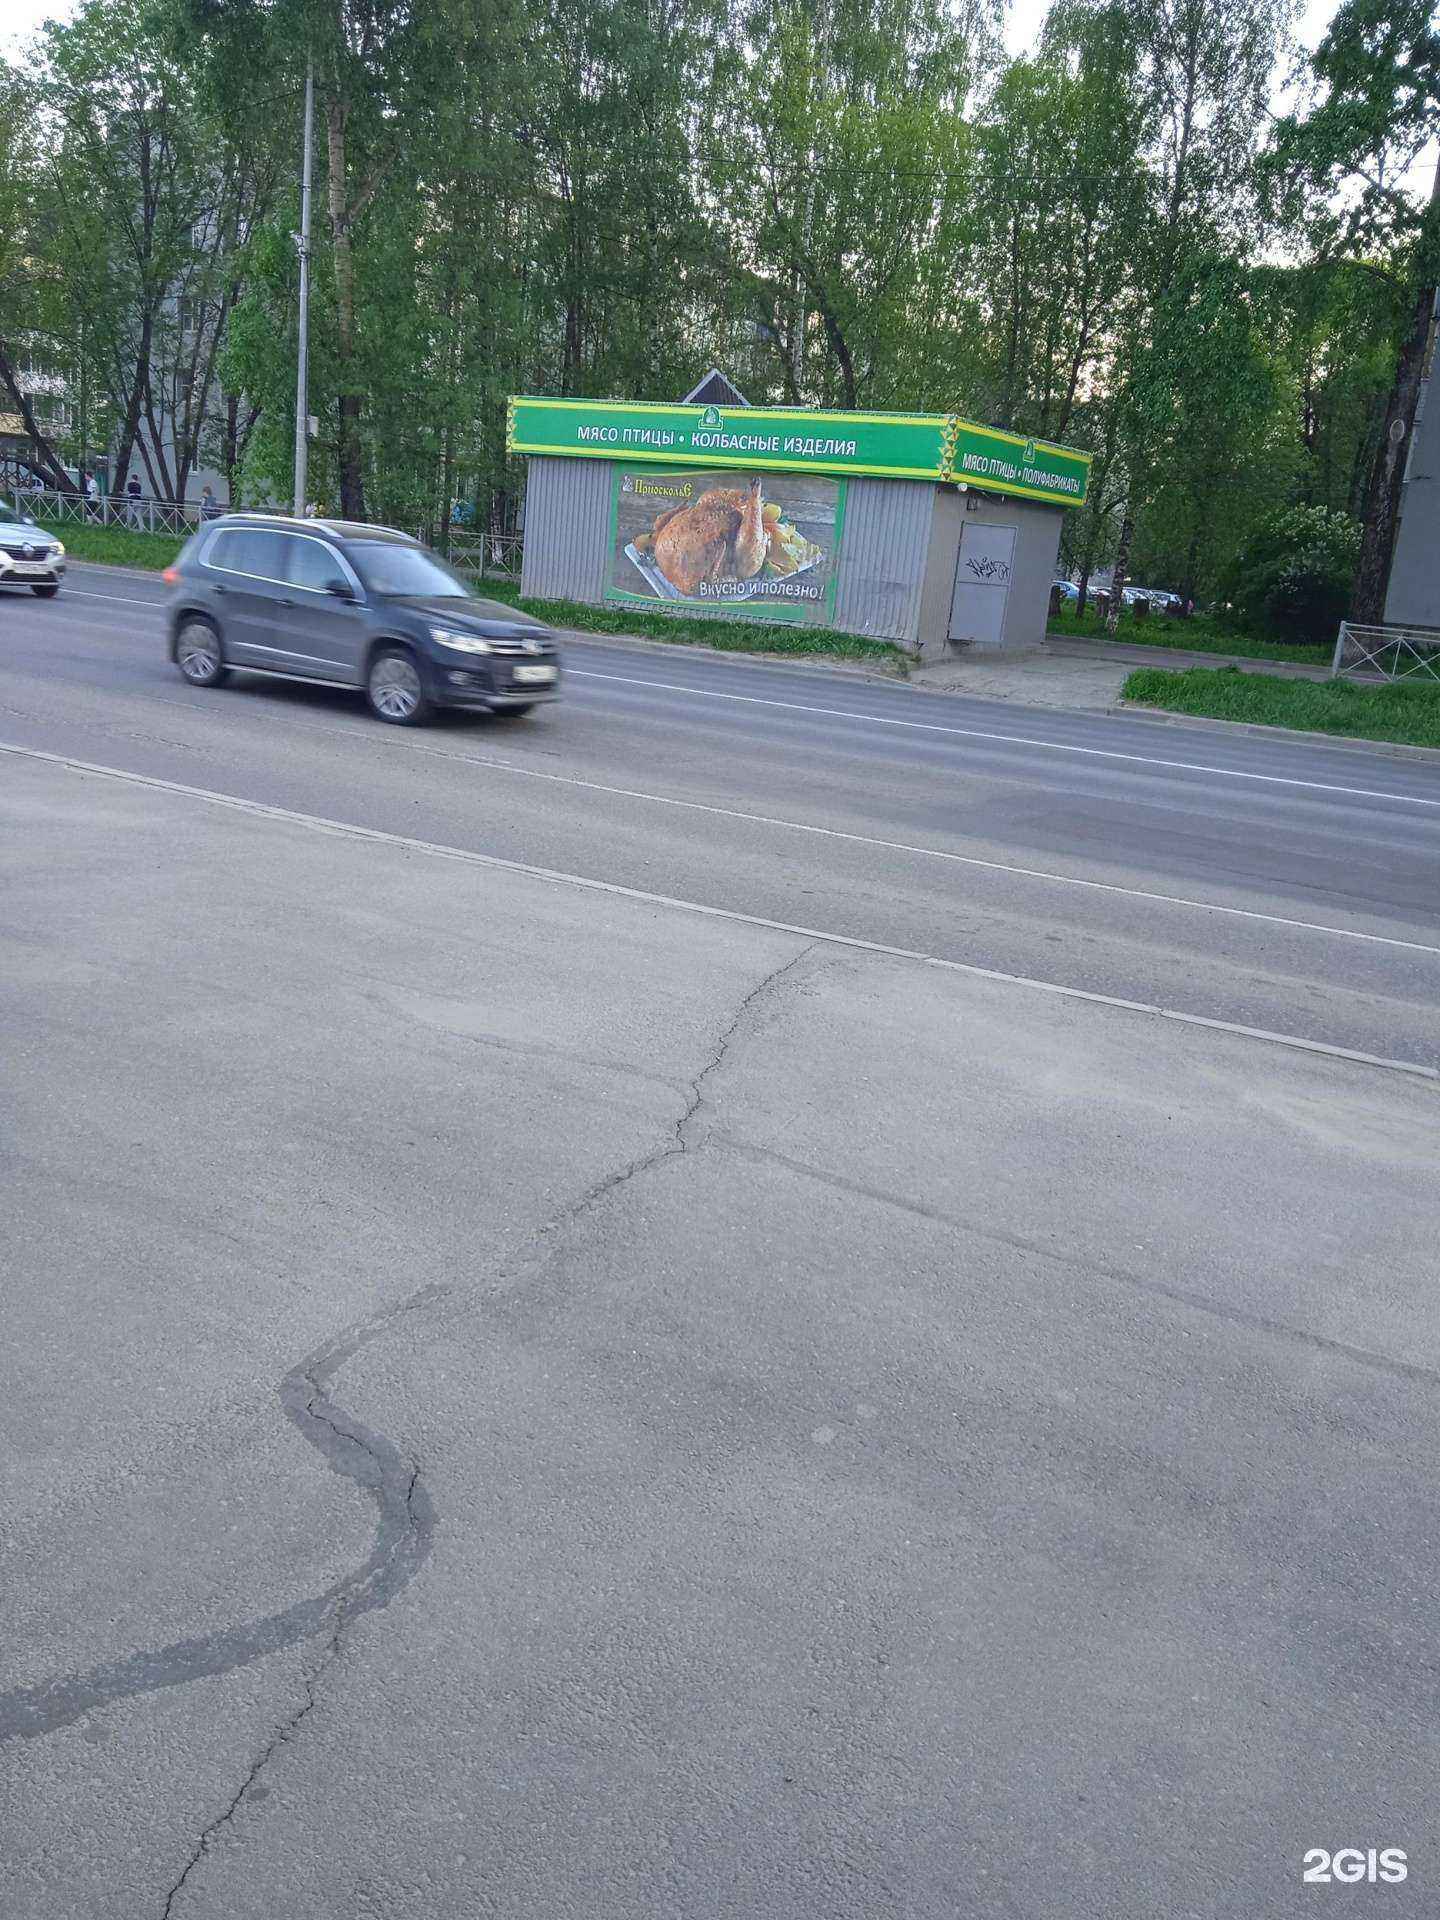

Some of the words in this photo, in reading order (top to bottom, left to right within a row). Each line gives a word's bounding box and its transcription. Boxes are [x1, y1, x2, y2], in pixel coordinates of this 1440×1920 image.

[577, 426, 618, 443] МЯСО
[622, 428, 674, 446] ПТИЦЫ
[691, 431, 779, 452] КОЛБАСНЫЕ
[784, 437, 857, 457] ИЗДЕЛИЯ
[962, 453, 988, 472] МЯСО
[990, 459, 1017, 481] ПТИЦЫ
[1022, 467, 1081, 492] ПОЛУФАБРИКАТЫ
[748, 582, 758, 595] и
[761, 582, 826, 600] полезно!
